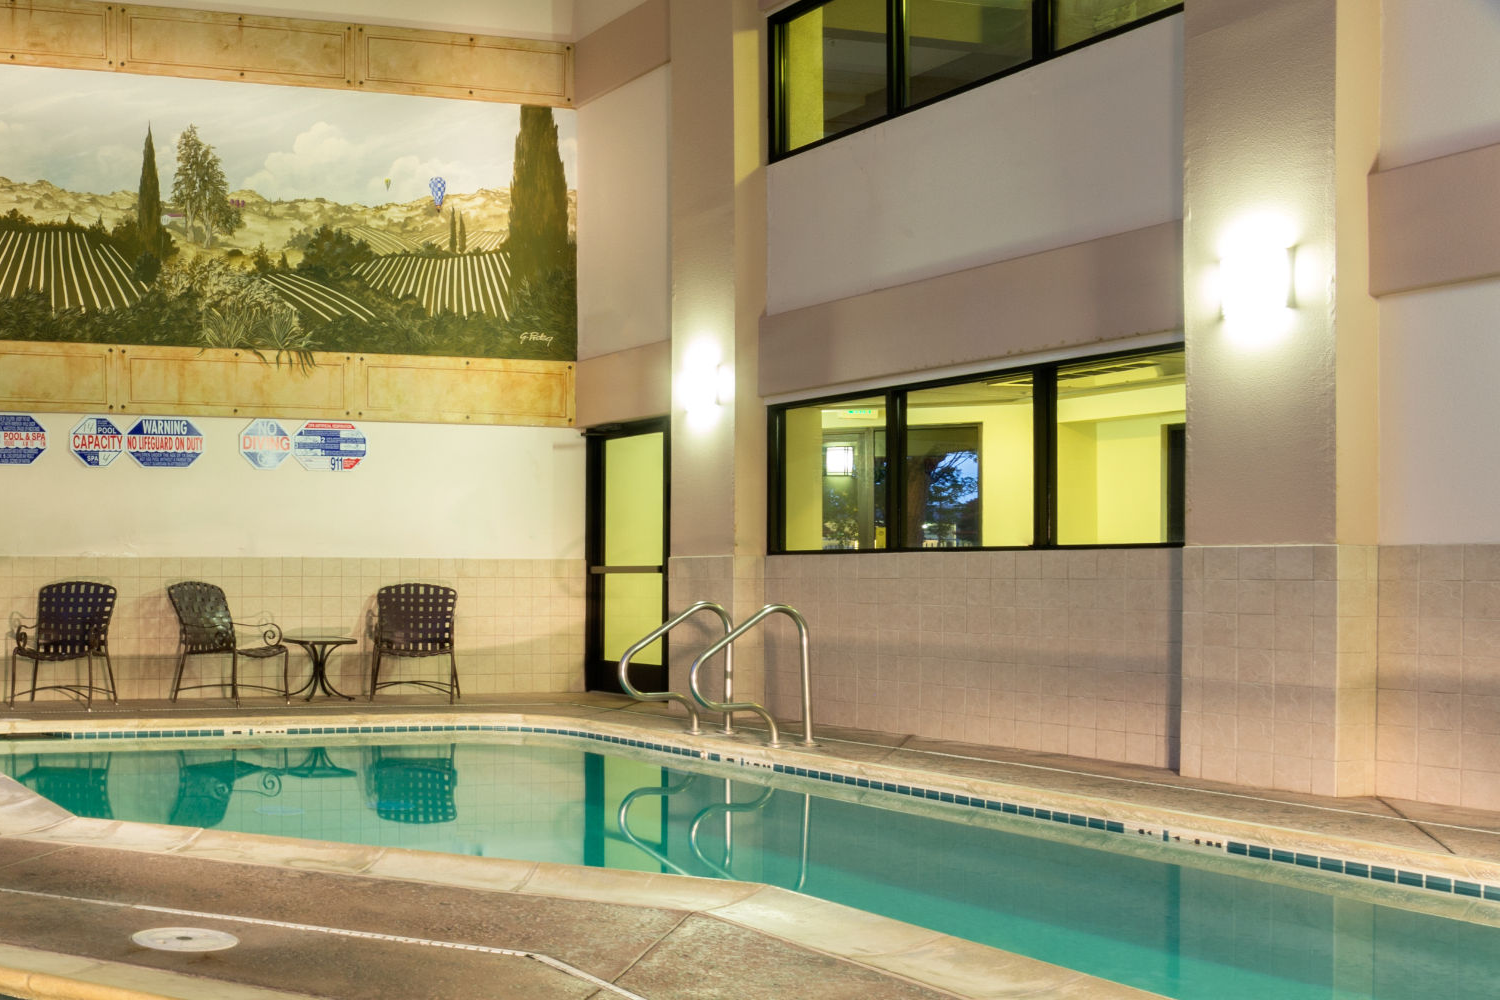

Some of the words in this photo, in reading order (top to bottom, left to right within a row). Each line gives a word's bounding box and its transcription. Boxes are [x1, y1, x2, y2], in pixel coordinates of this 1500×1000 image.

[142, 420, 188, 434] WARNING
[3, 432, 24, 441] POOL
[25, 433, 31, 441] &
[32, 433, 46, 441] SPA
[73, 434, 123, 449] CAPACITY
[127, 436, 137, 450] NO
[139, 436, 173, 450] LIFEGUARD
[175, 436, 185, 450] ON
[187, 437, 203, 451] DUTY
[243, 436, 290, 451] DIVING
[330, 457, 343, 471] 911
